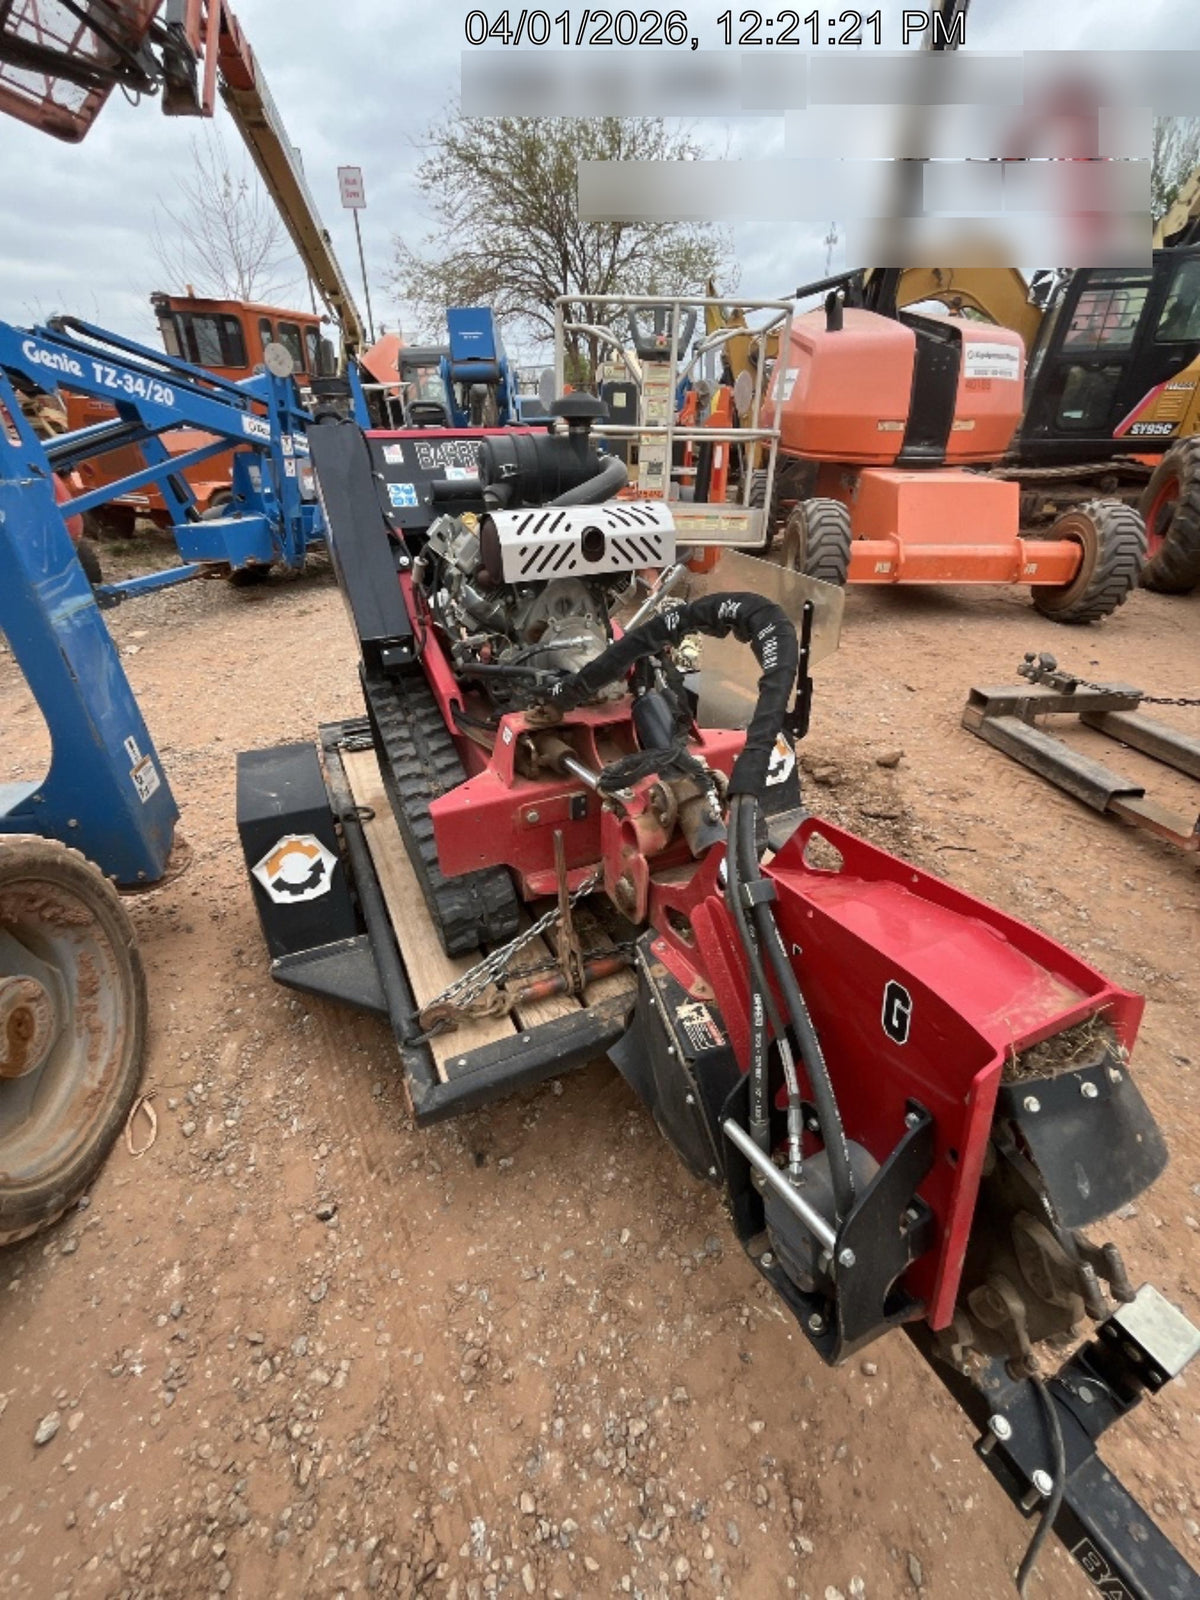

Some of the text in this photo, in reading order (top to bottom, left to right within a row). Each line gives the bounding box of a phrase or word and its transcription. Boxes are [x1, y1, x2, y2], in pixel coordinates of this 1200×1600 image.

[22, 340, 174, 406] Genie TZ-34/20
[1130, 422, 1172, 435] SY95C
[881, 979, 913, 1046] G
